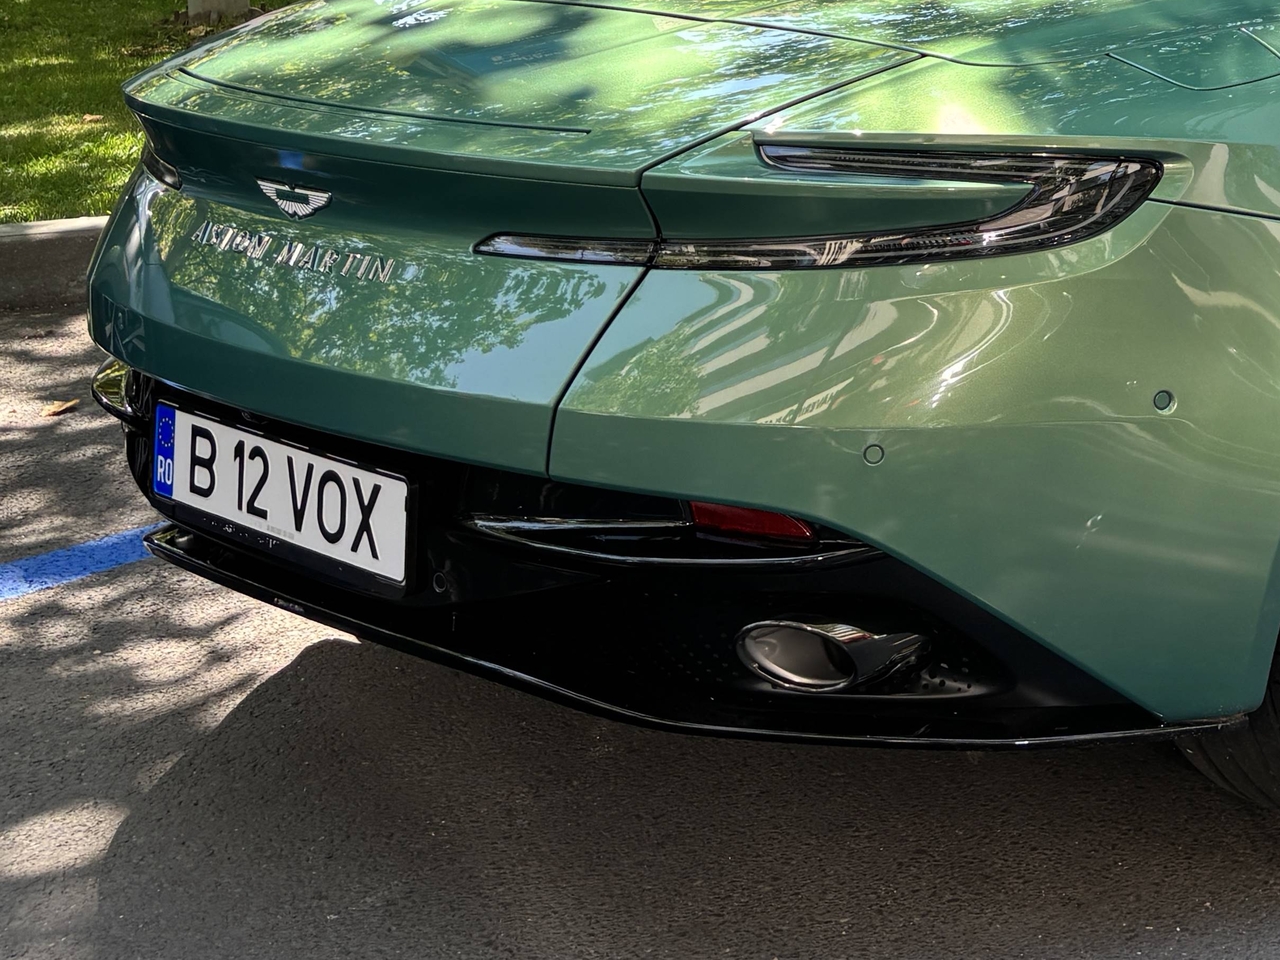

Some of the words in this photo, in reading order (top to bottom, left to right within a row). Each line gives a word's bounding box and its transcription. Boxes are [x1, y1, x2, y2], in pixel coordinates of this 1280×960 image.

[190, 220, 273, 260] ASTON
[275, 240, 395, 284] MARTIN
[157, 455, 173, 485] RO
[189, 424, 217, 498] B
[234, 440, 270, 520] 12
[287, 455, 382, 560] VOX
